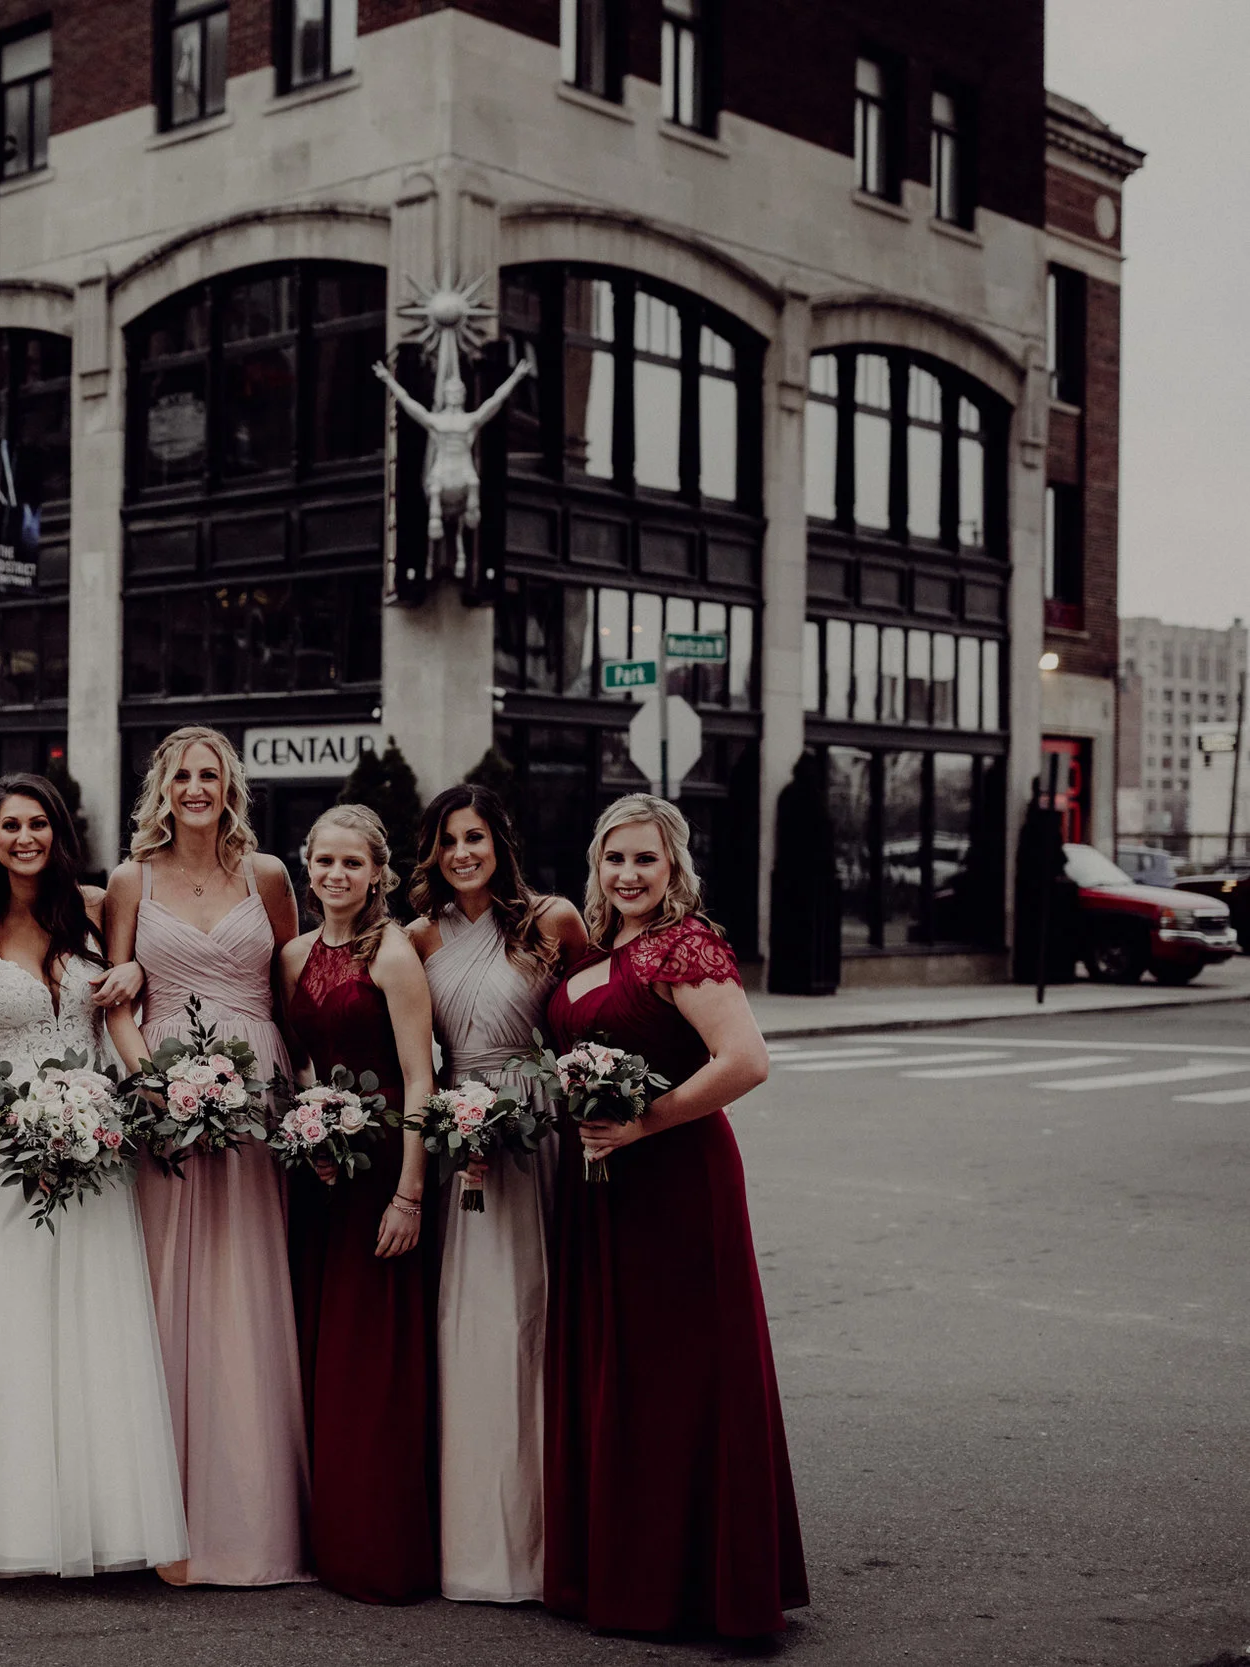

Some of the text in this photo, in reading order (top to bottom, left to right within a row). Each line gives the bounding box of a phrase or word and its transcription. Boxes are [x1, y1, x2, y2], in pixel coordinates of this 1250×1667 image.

[0, 544, 15, 559] THE
[614, 665, 646, 685] Park
[252, 735, 376, 766] CENTAUR
